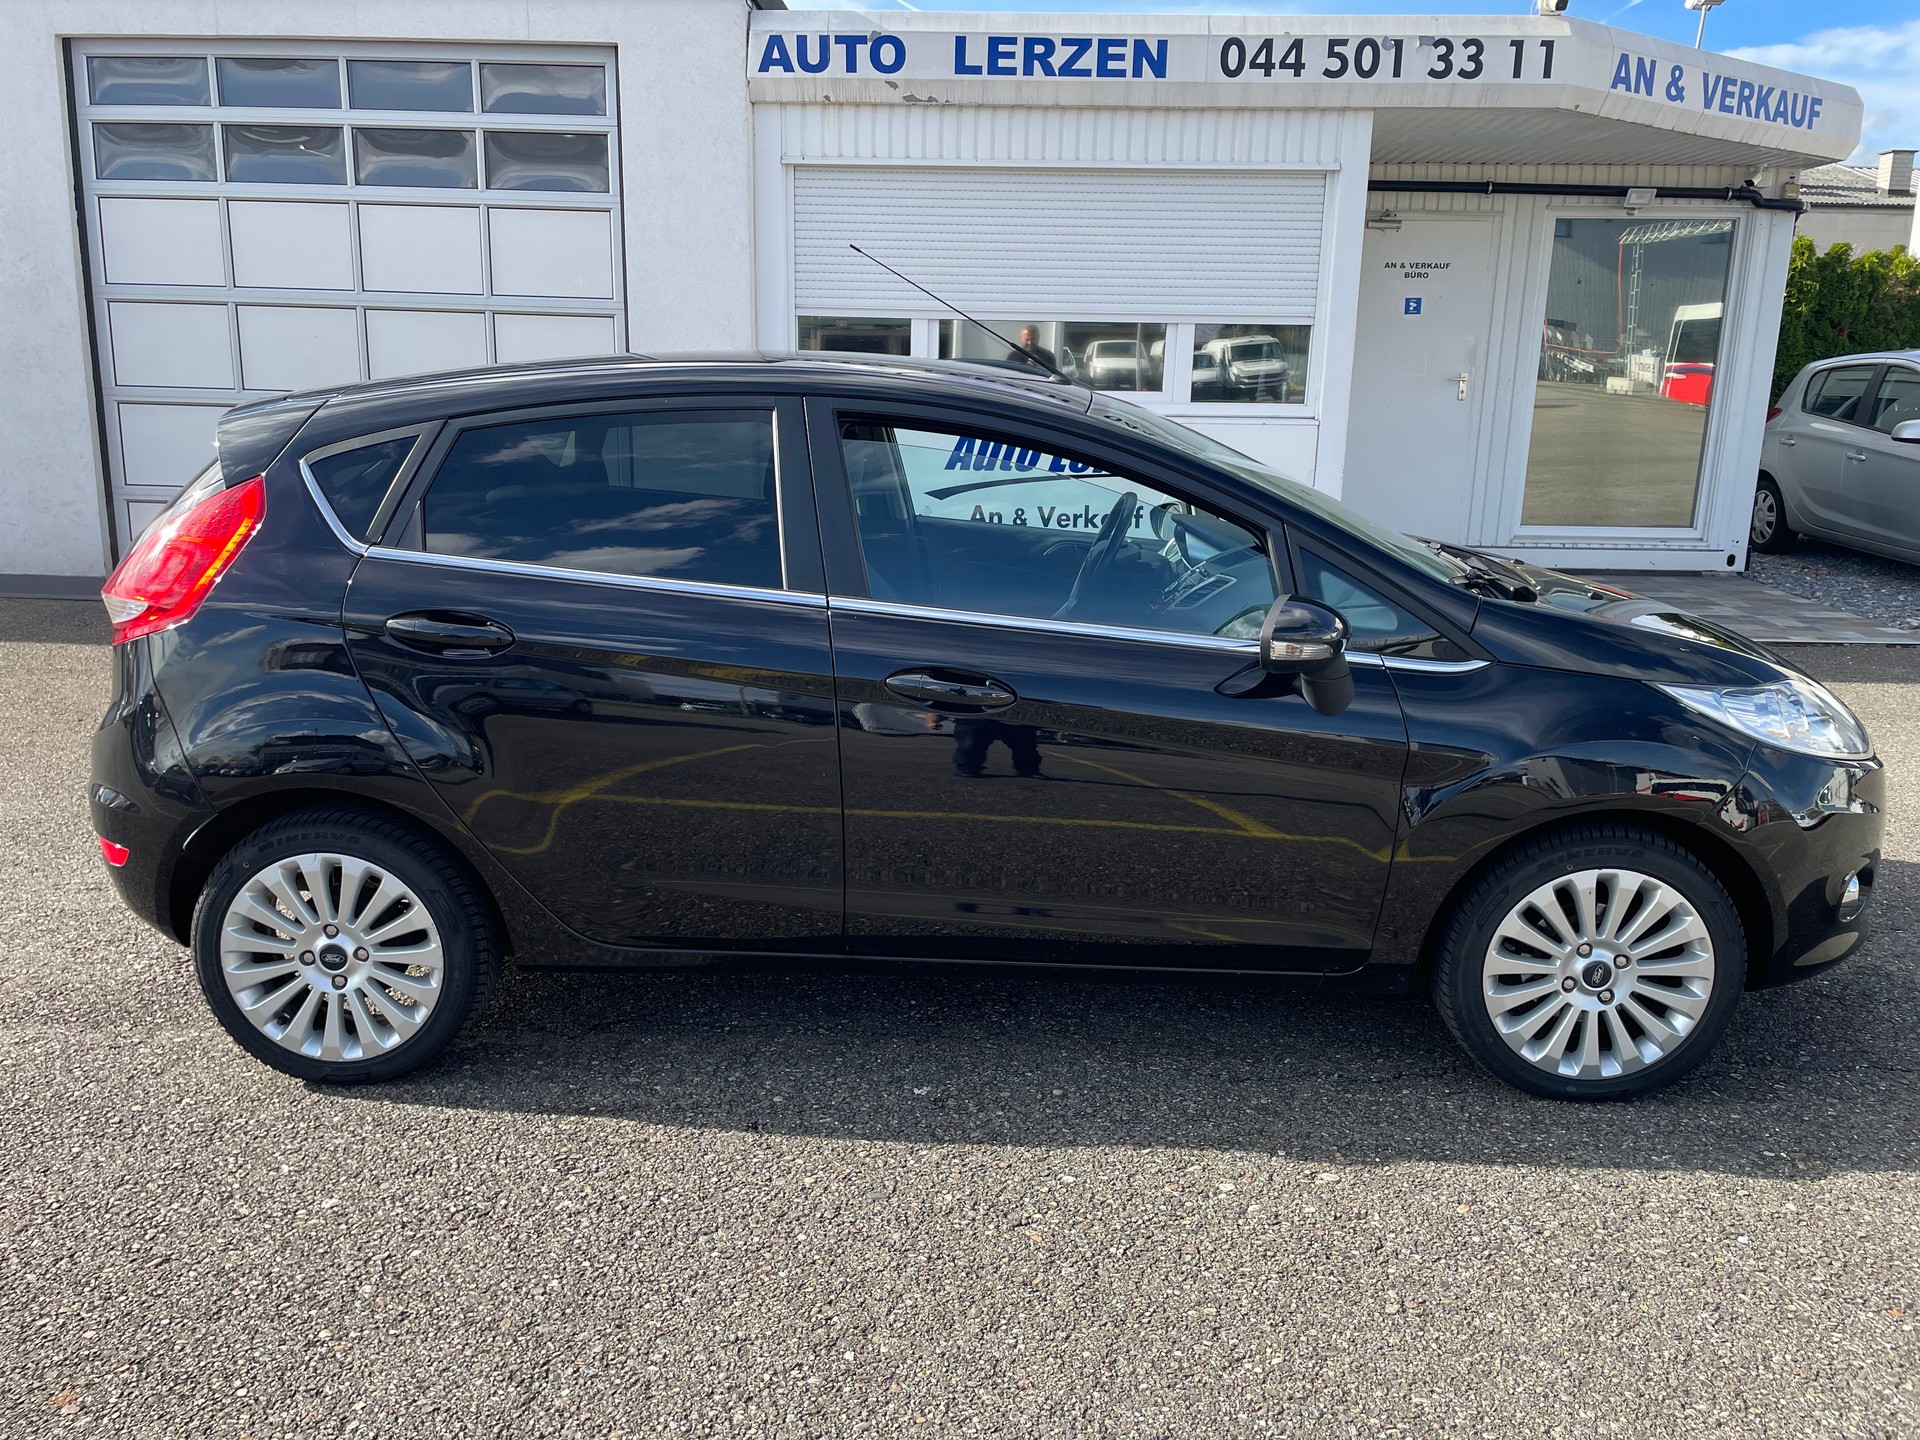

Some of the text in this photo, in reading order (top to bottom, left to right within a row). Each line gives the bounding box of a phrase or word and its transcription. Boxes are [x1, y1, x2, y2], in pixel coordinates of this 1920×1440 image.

[757, 34, 1555, 80] AUTO LERZEN 044 501 33 11
[1611, 53, 1823, 130] AN & VERKAUF
[1404, 271, 1429, 279] BÜRO
[1409, 262, 1452, 270] VERKAUF
[970, 504, 1144, 529] An & Verkf
